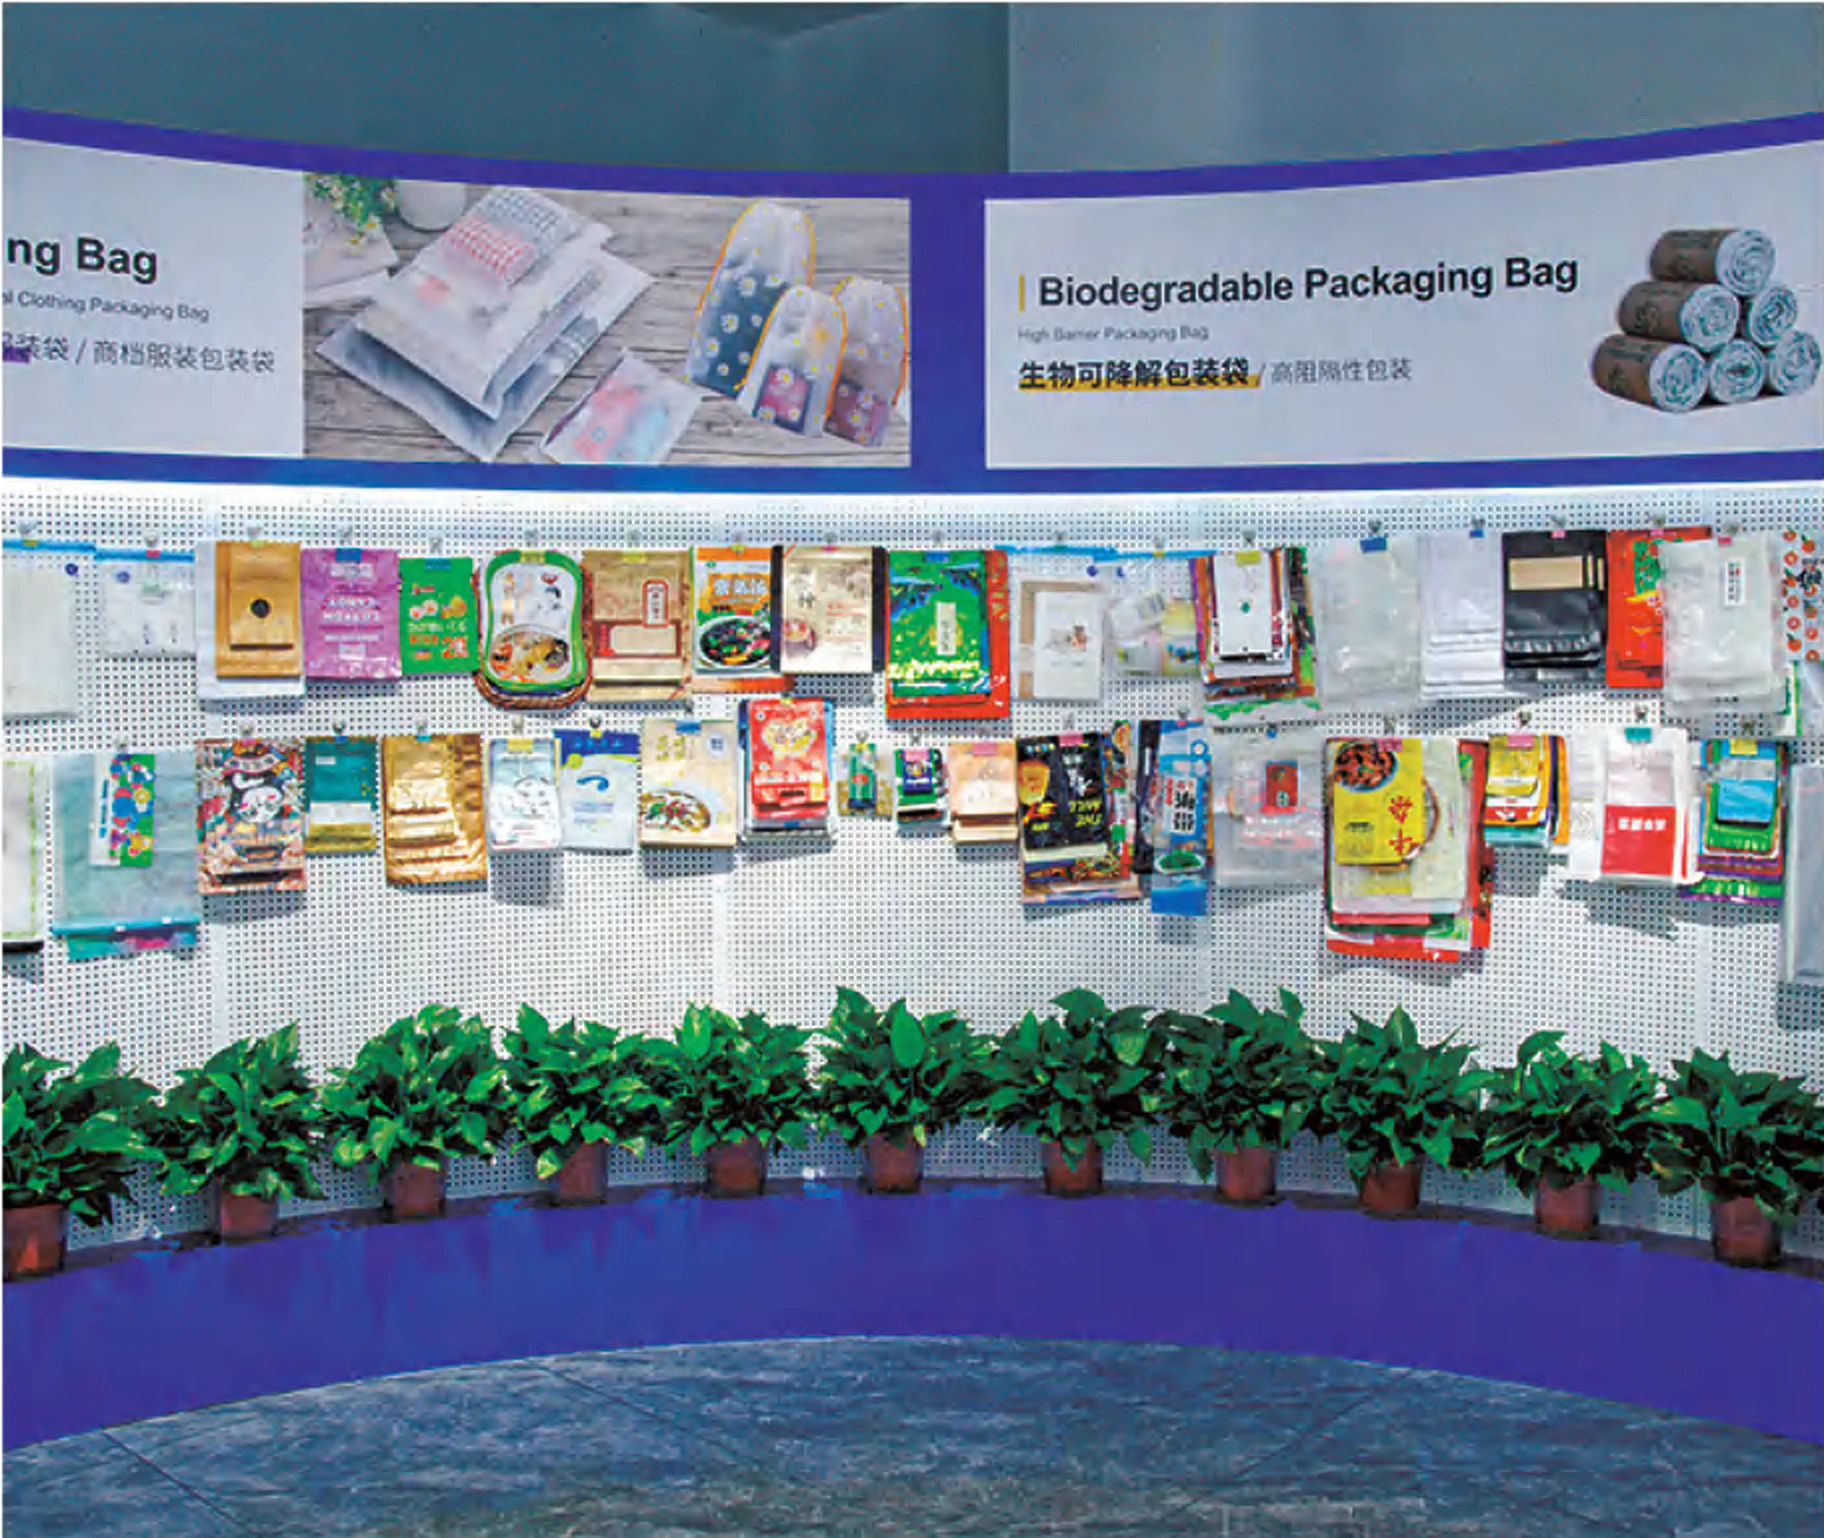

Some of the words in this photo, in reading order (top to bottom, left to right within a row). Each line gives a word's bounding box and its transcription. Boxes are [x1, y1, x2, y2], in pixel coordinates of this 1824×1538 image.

[6, 237, 61, 276] ng
[76, 237, 158, 285] Bag
[1039, 271, 1294, 312] Biodegradable
[1305, 262, 1493, 301] Packaging
[1505, 257, 1578, 293] Bag
[17, 291, 86, 315] Clothing
[90, 297, 173, 321] Packaging
[177, 304, 209, 323] Bag
[1103, 326, 1178, 342] Packaging
[1180, 325, 1210, 341] Bag
[1019, 358, 1250, 389] 生物可降解包装袋
[1271, 358, 1412, 385] 高阻隔性包装
